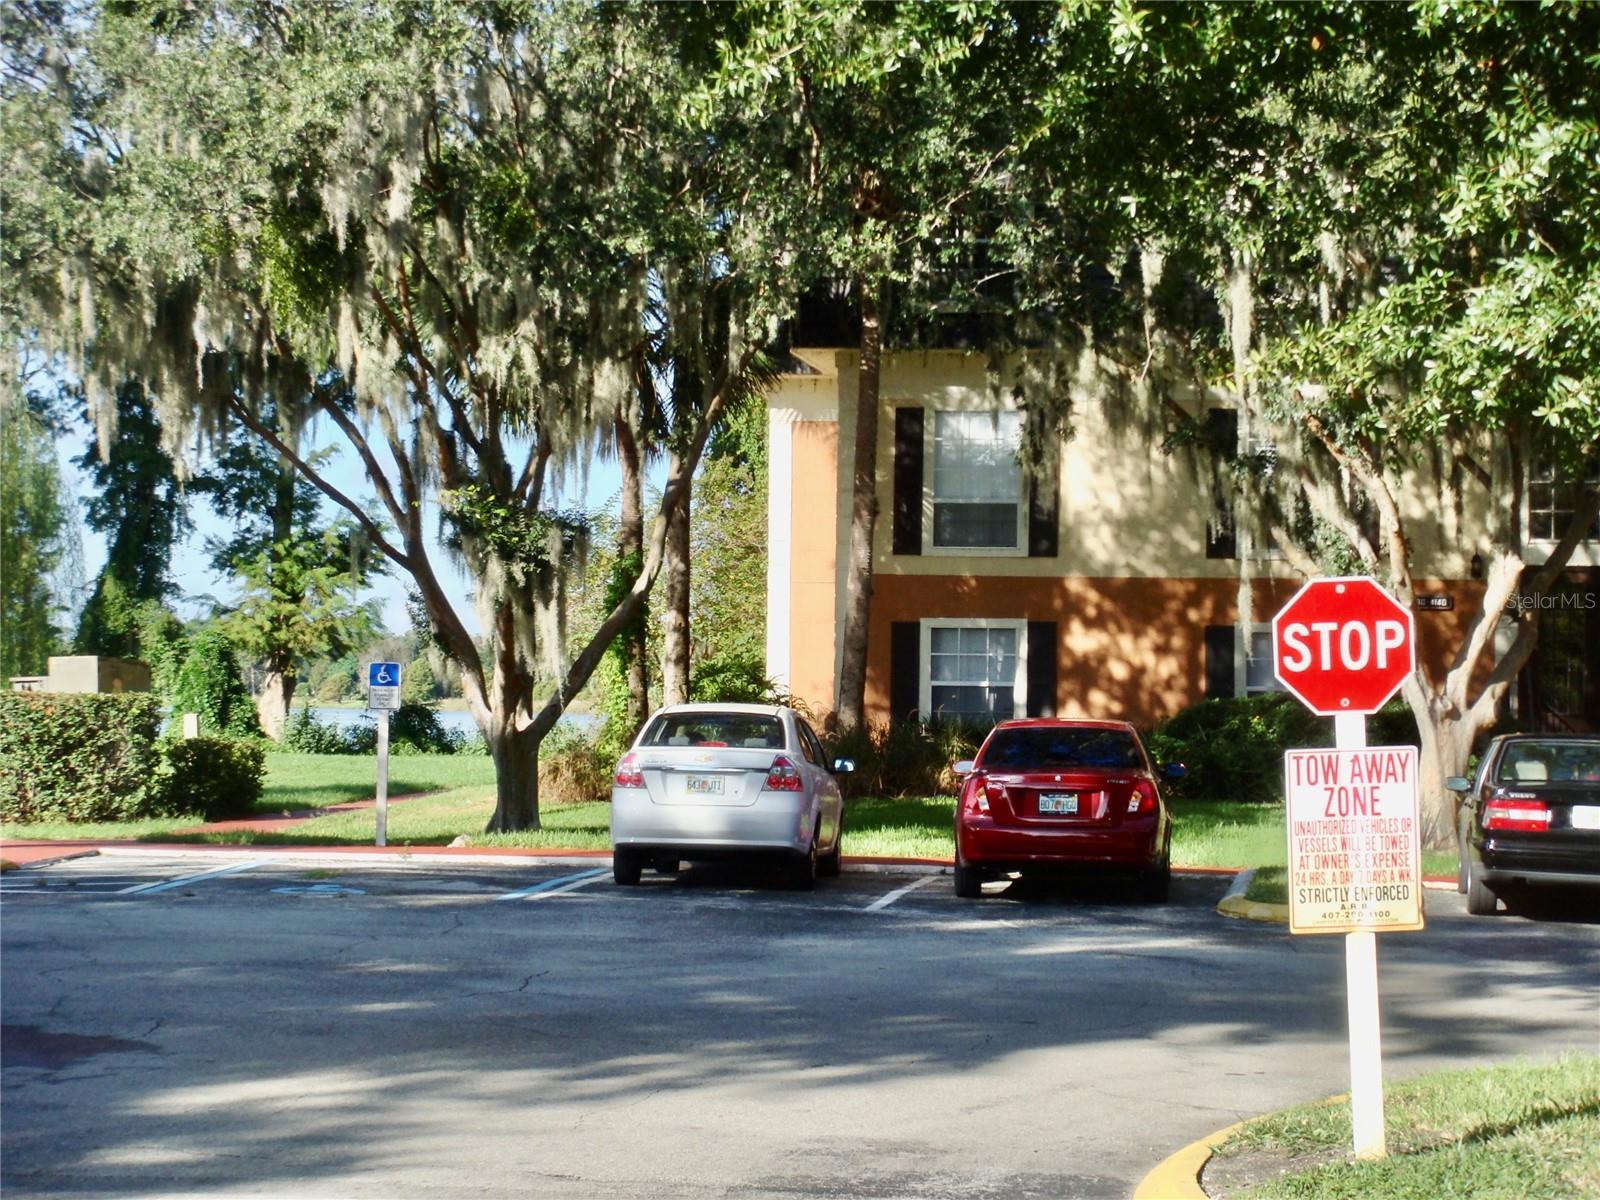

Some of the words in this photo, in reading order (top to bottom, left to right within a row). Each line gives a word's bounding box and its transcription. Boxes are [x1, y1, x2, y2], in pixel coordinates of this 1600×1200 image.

[1283, 620, 1405, 673] STOP
[1292, 754, 1339, 786] TOW
[1350, 752, 1410, 784] AWAY
[1324, 786, 1381, 818] ZONE
[1294, 820, 1357, 837] UNAUTHORIZED
[1360, 818, 1399, 835] VEHICLES
[1401, 818, 1412, 833] OR
[1298, 837, 1338, 854] VESSELS
[1340, 836, 1361, 852] WILL
[1365, 836, 1377, 851] BE
[1380, 834, 1409, 850] TOWED
[1298, 855, 1310, 871] AT
[1364, 852, 1410, 868] EXPENSE
[1295, 872, 1307, 886] 24
[1331, 871, 1338, 885] A
[1340, 871, 1354, 885] DAY
[1366, 869, 1387, 884] DAYS
[1390, 869, 1395, 883] A
[1299, 887, 1350, 904] STRICTLY
[1354, 884, 1409, 902] ENFORCED
